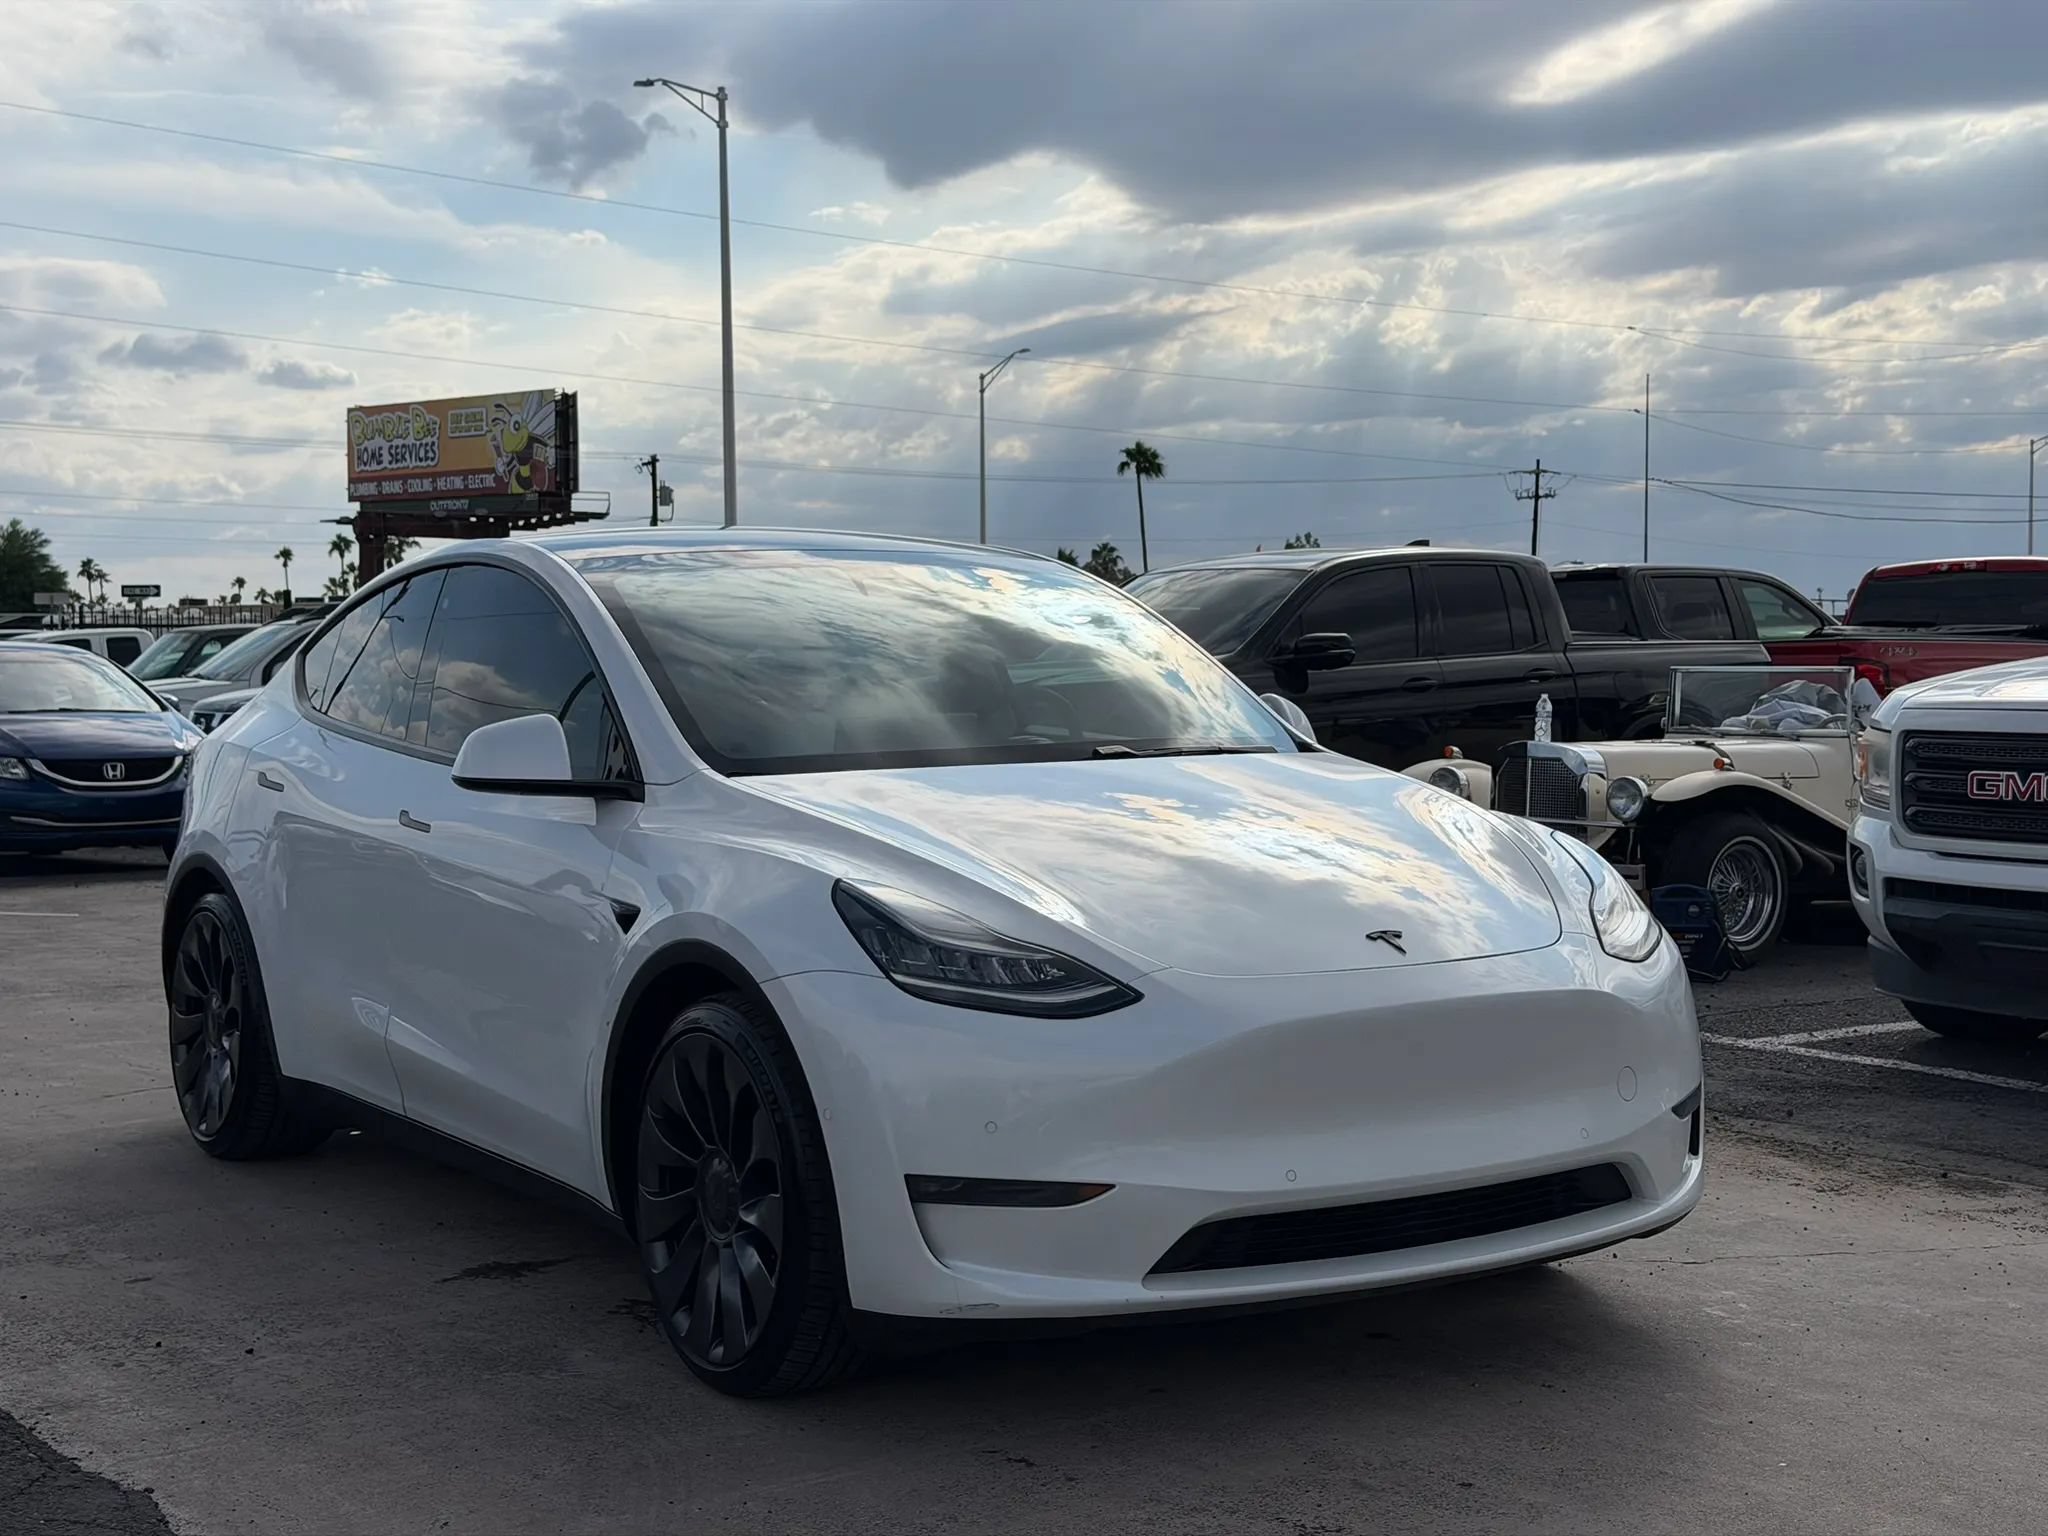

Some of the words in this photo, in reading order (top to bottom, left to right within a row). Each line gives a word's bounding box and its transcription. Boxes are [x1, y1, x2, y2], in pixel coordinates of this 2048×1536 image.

[350, 413, 411, 446] BUMBLE
[410, 406, 438, 441] BEE
[356, 447, 383, 469] HOME
[388, 442, 437, 465] SERVICES
[407, 479, 432, 492] COOLING
[437, 477, 463, 490] HEATING
[468, 475, 496, 488] ELECTRIC
[1968, 770, 2048, 802] GM
